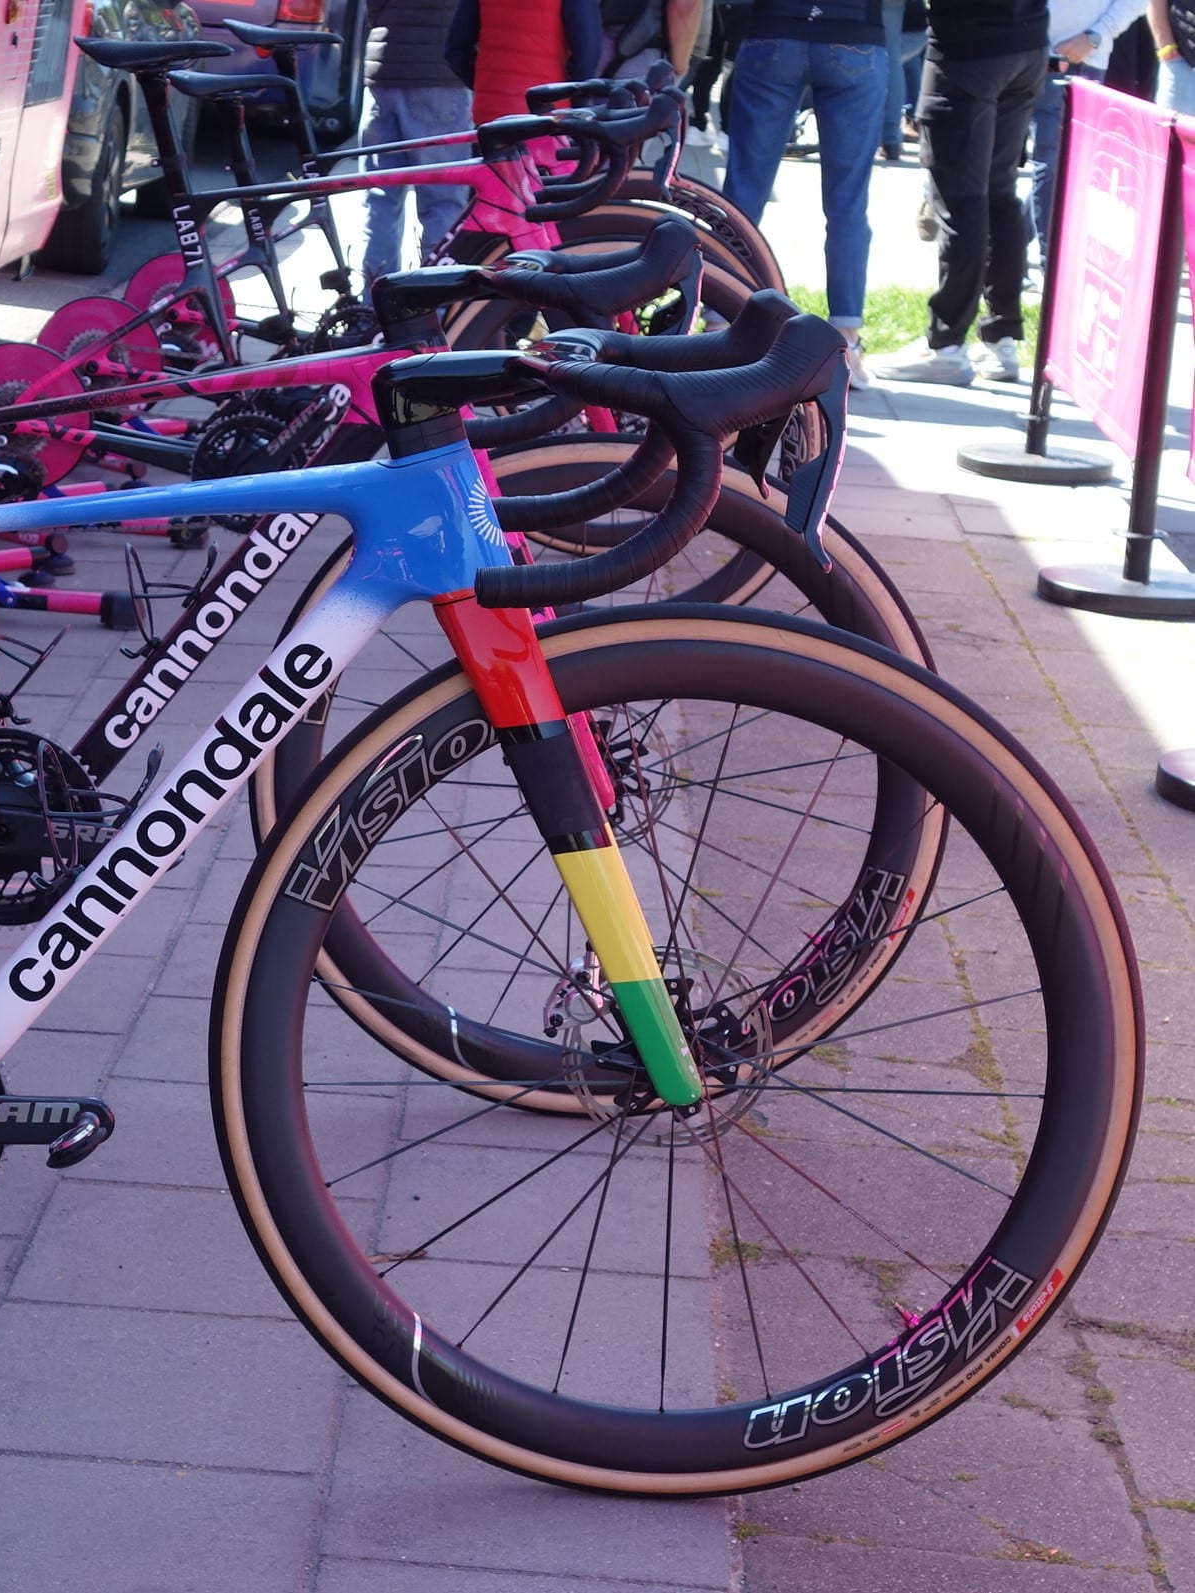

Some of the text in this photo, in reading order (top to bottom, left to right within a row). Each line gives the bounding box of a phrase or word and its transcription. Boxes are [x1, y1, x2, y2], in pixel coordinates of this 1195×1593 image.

[173, 205, 204, 267] LAB71
[105, 513, 319, 750] cannonda
[9, 642, 333, 1002] cannondale
[964, 1362, 984, 1382] PRO
